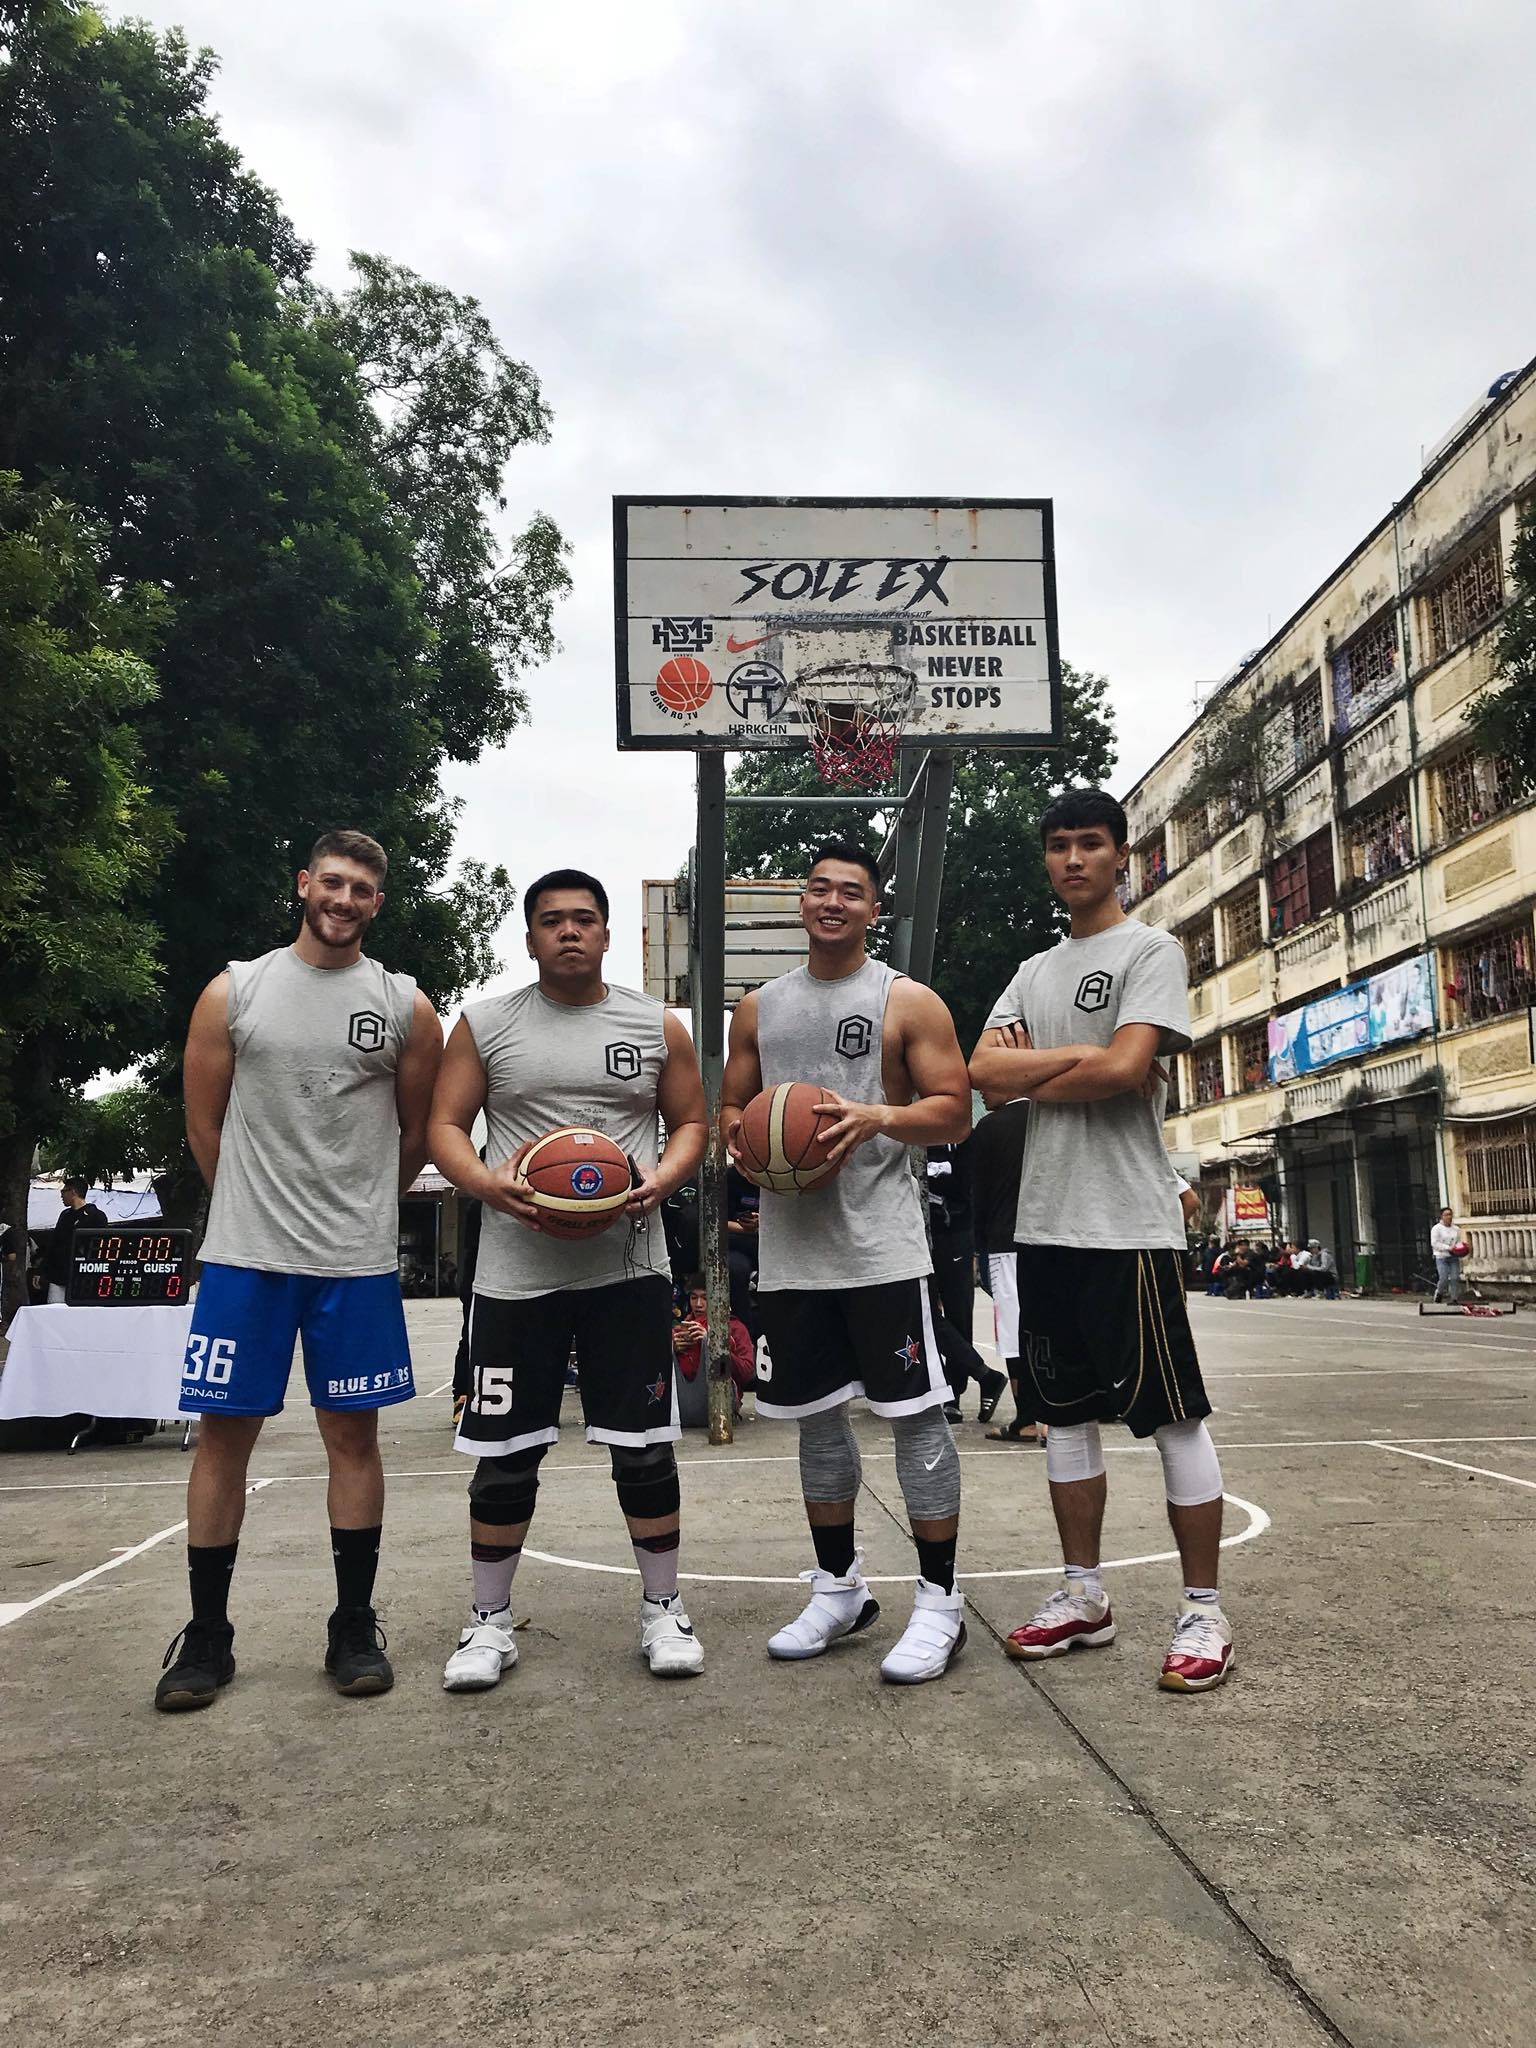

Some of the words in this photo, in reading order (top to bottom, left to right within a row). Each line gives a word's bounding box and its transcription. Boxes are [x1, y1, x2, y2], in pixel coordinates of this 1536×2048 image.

[731, 559, 874, 606] SOLE
[875, 555, 950, 611] EX
[893, 625, 1037, 646] BASKETBALL
[928, 656, 1003, 677] NEVER
[649, 690, 668, 714] BONG
[688, 711, 699, 720] TV
[931, 686, 1002, 708] STOPS
[728, 724, 787, 735] HBRKCHN
[97, 1237, 171, 1261] 10:00
[79, 1263, 109, 1273] HOME
[143, 1263, 177, 1273] GUEST
[183, 1333, 236, 1384] 36
[328, 1376, 368, 1394] BLUE
